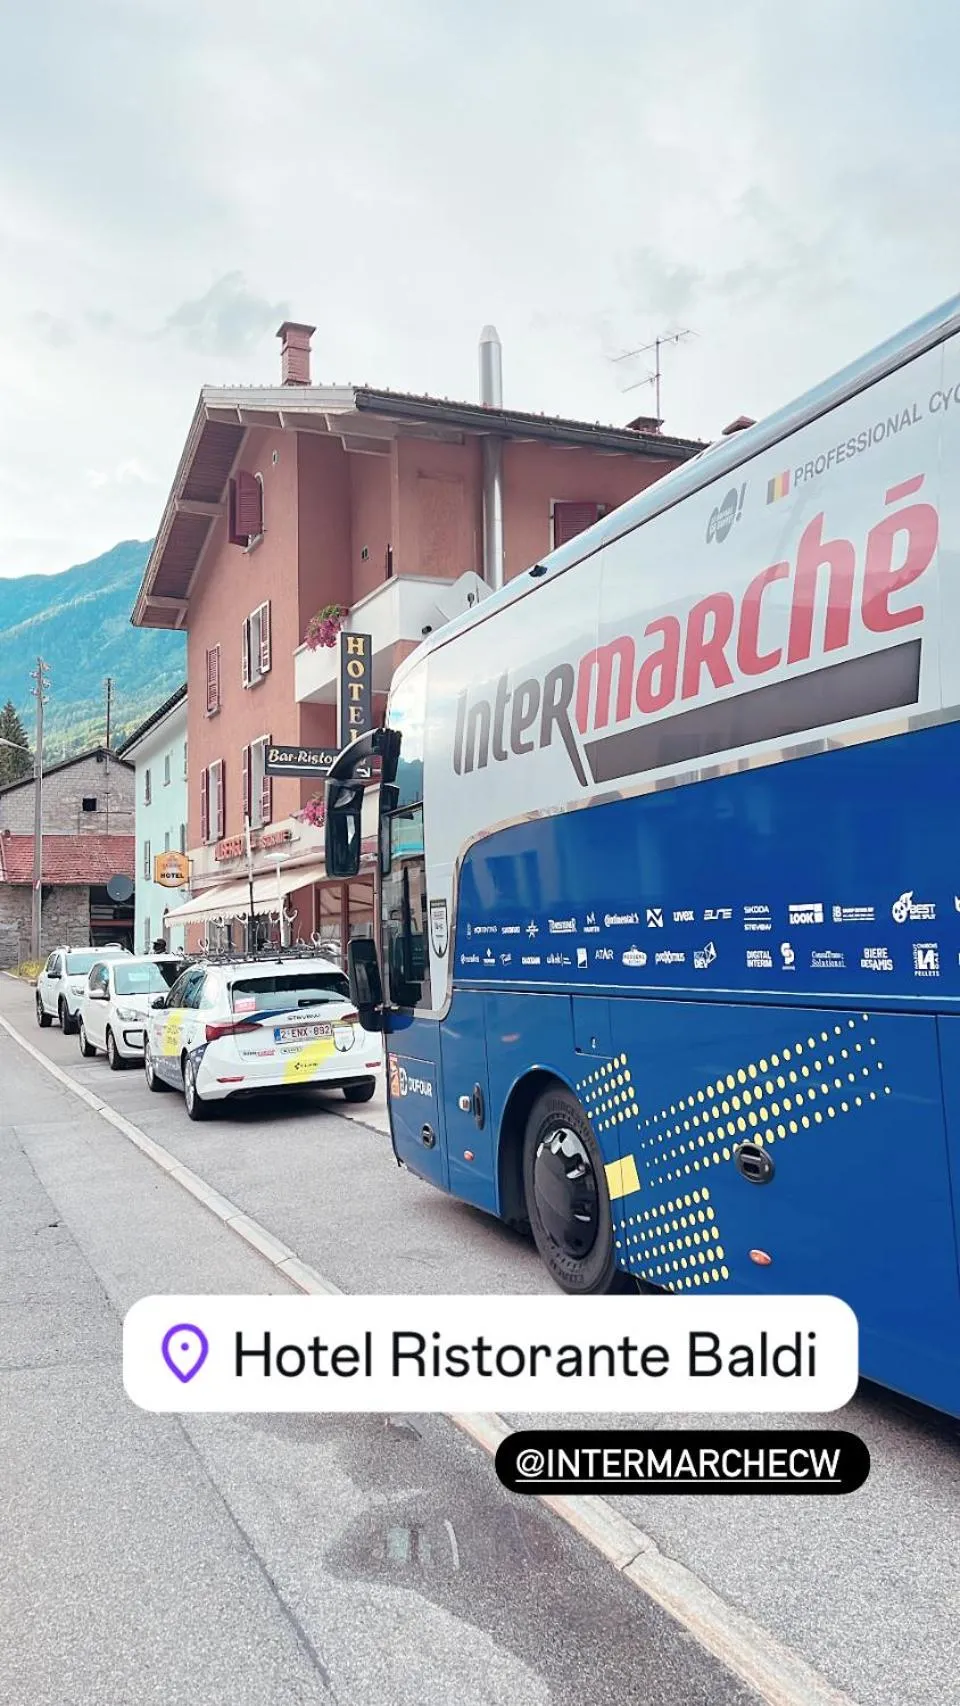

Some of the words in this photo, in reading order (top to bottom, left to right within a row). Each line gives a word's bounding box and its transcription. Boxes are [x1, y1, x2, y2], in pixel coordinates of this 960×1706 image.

[794, 403, 922, 487] PROFESSIONAL
[673, 911, 695, 922] uvex
[789, 912, 815, 924] LOOK
[864, 948, 888, 959] BIERE
